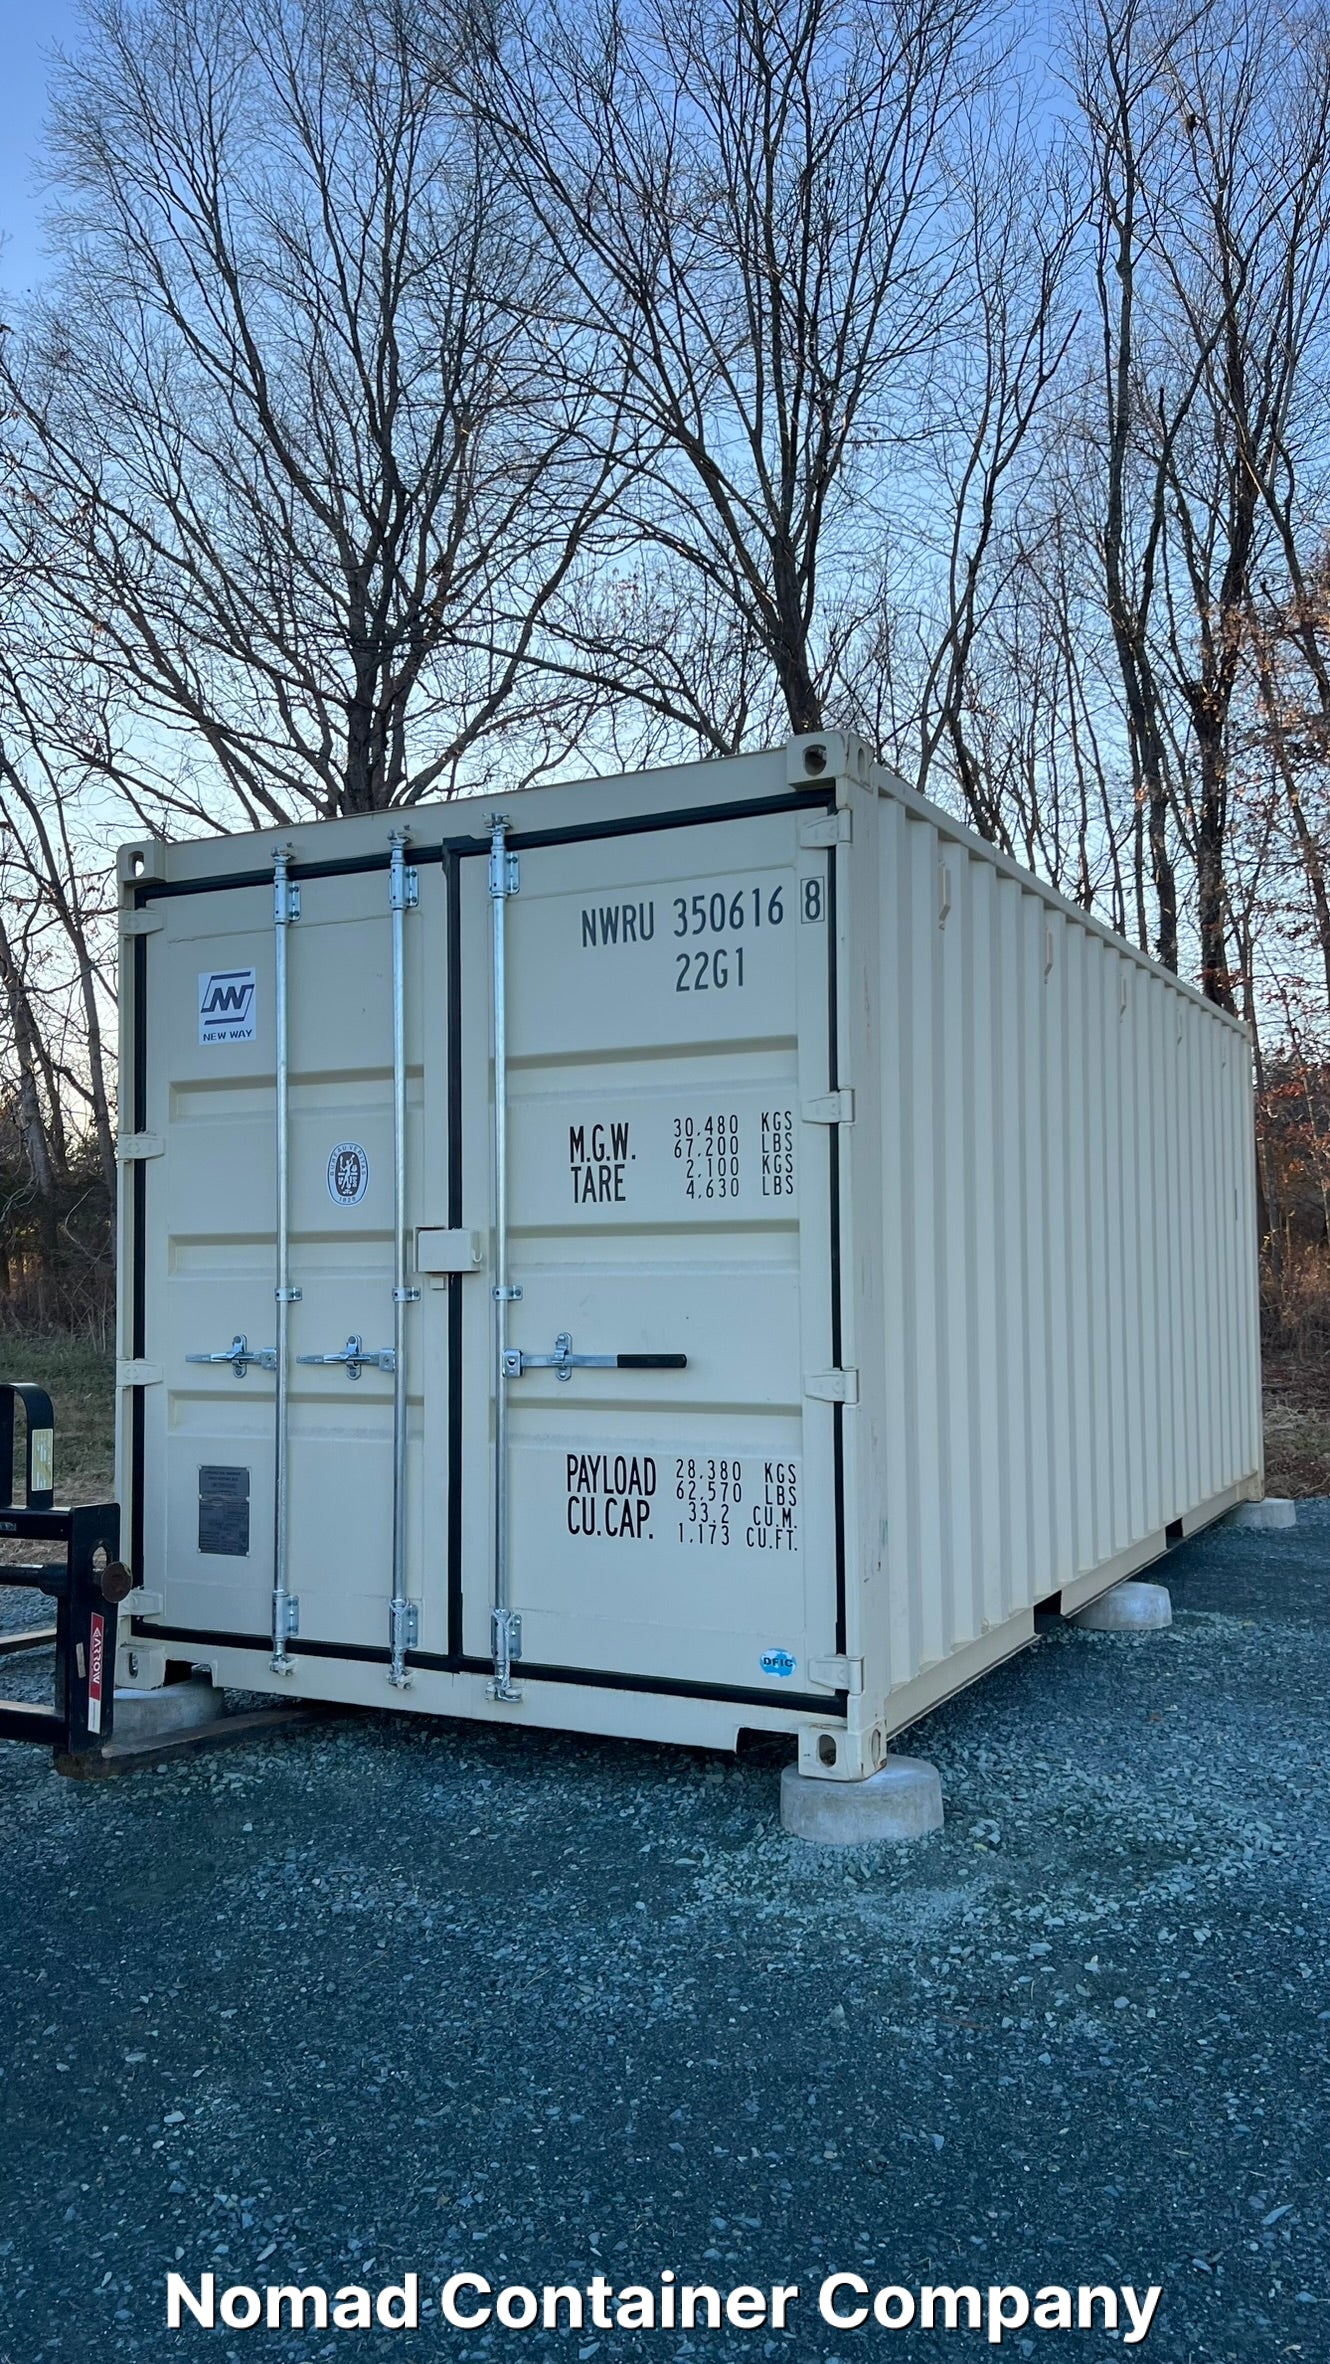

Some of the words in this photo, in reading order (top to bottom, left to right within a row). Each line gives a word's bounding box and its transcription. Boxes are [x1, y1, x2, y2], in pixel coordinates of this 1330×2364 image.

[581, 901, 655, 948] NWRU
[673, 885, 784, 937] 350616
[804, 879, 821, 921] 8
[675, 947, 744, 992] 22G1
[203, 1031, 227, 1041] NEW
[229, 1029, 252, 1039] WAY
[569, 1122, 636, 1163] M.G.W.
[761, 1110, 793, 1132] KGS
[761, 1132, 793, 1153] LBS
[329, 1144, 347, 1177] BUREAU
[349, 1144, 367, 1176] VERITAS
[570, 1164, 627, 1203] TARE
[762, 1153, 794, 1175] KGS
[762, 1174, 794, 1196] LBS
[566, 1453, 656, 1496] PAYLOAD
[764, 1462, 797, 1485] KGS
[765, 1484, 797, 1507] LBS
[567, 1495, 654, 1539] CU.CAP.
[688, 1501, 729, 1524] 33.2
[753, 1505, 798, 1529] CU.M.
[746, 1527, 798, 1551] CU.FT.
[92, 1637, 102, 1685] ARROW
[763, 1657, 793, 1668] DFIC
